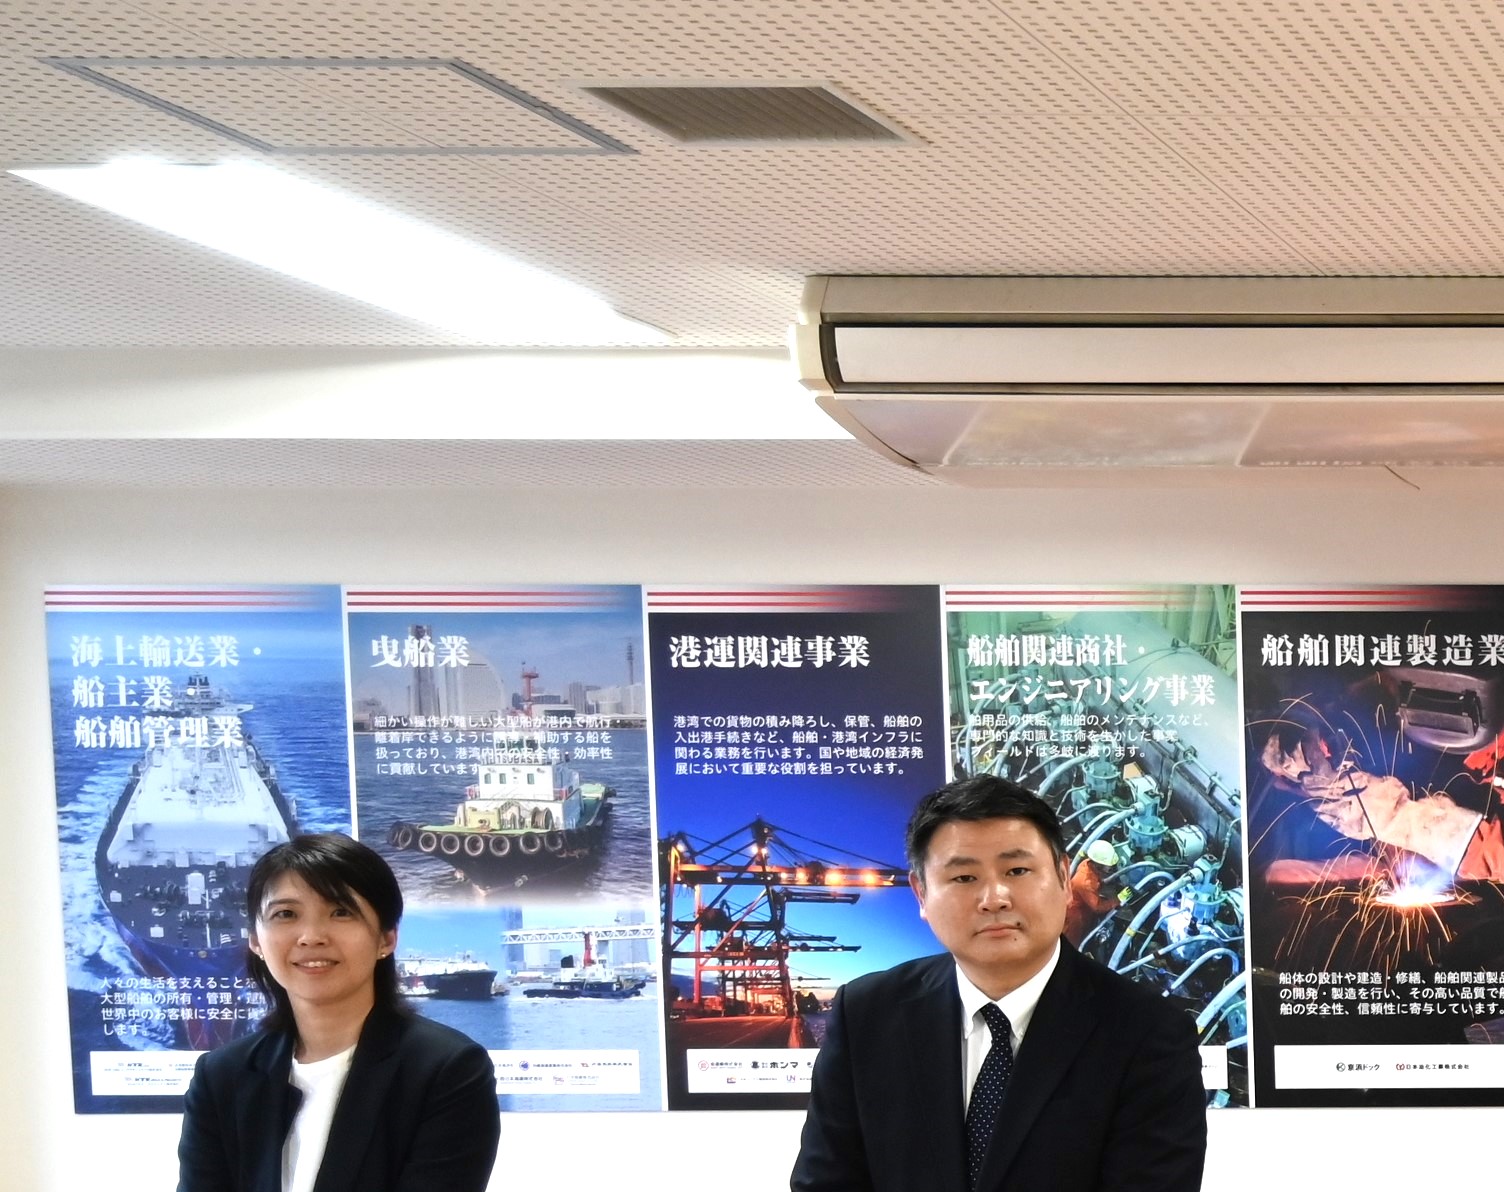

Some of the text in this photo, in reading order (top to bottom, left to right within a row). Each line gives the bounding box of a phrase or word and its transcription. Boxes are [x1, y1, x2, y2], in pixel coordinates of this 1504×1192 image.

[370, 635, 470, 668] 曳船業
[669, 635, 871, 668] 港運関連事業
[970, 674, 1216, 706] エンジニアリング事業
[74, 715, 244, 748] 船舶管理業
[673, 715, 923, 728] 港湾での貨物の積み降ろし、保管、船舶の
[674, 731, 923, 744] 入出港手続きなど、船舶・港湾インフラに
[675, 747, 924, 760] 関わる業務を行います。国や地域の経済発
[675, 762, 904, 775] 展において重要な役割を担っています。
